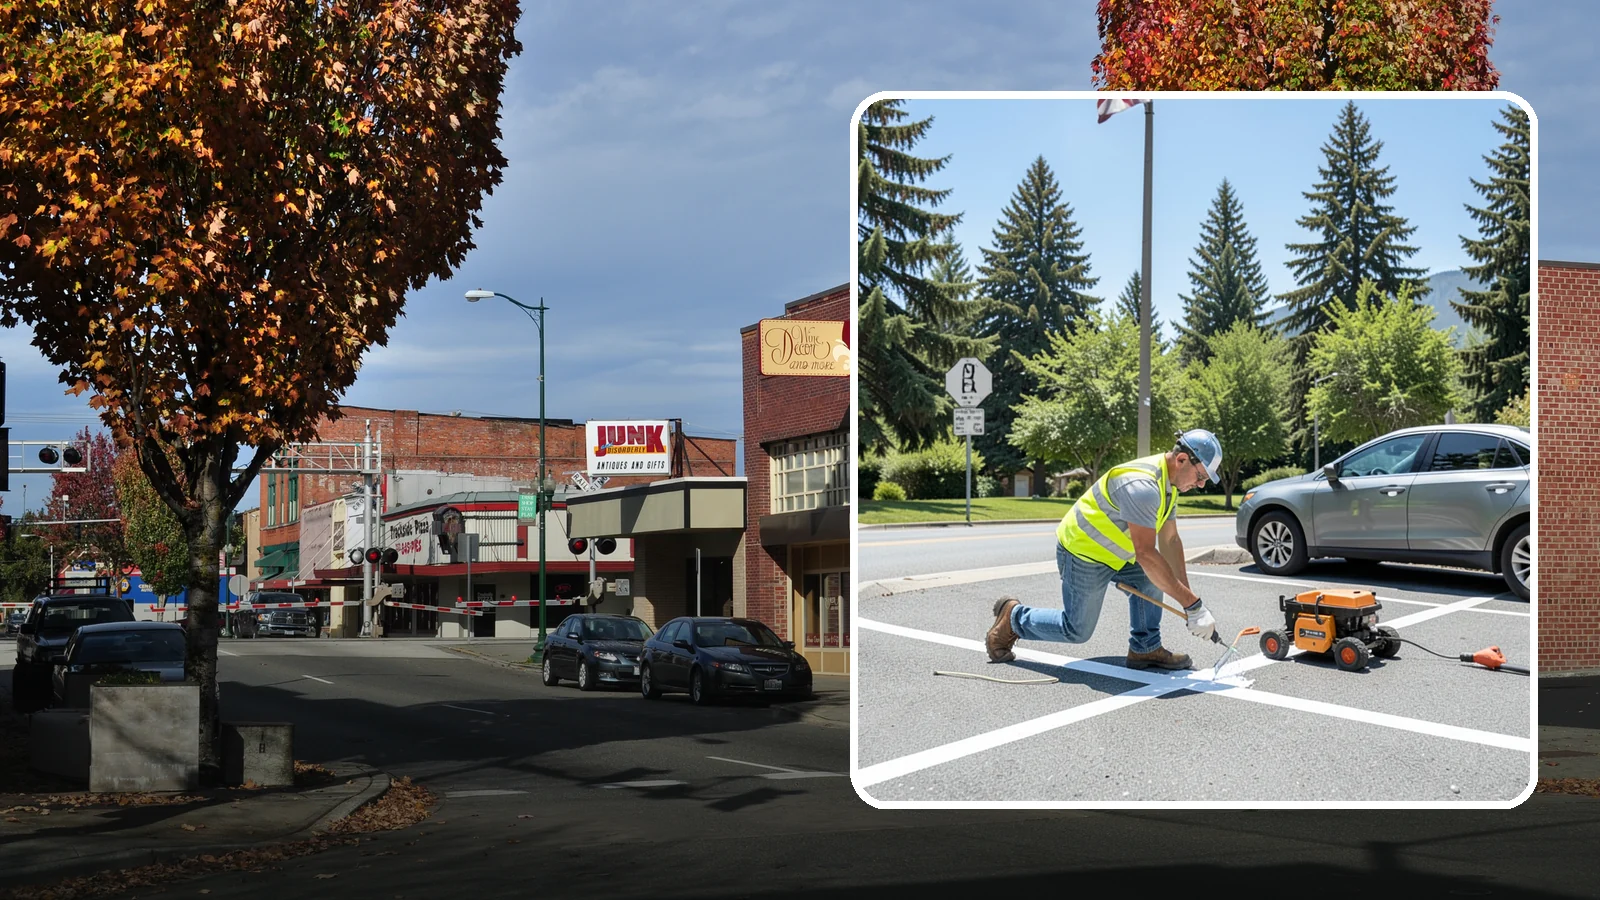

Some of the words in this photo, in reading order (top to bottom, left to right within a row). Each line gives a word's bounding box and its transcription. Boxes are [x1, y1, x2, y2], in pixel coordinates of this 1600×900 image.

[595, 425, 665, 457] JUNK
[607, 446, 646, 454] DISORDERLY
[597, 461, 628, 470] ANTIQUES
[631, 461, 644, 470] AND
[647, 461, 665, 470] GIFTS
[390, 521, 413, 539] Trackside
[414, 519, 429, 535] Pizza
